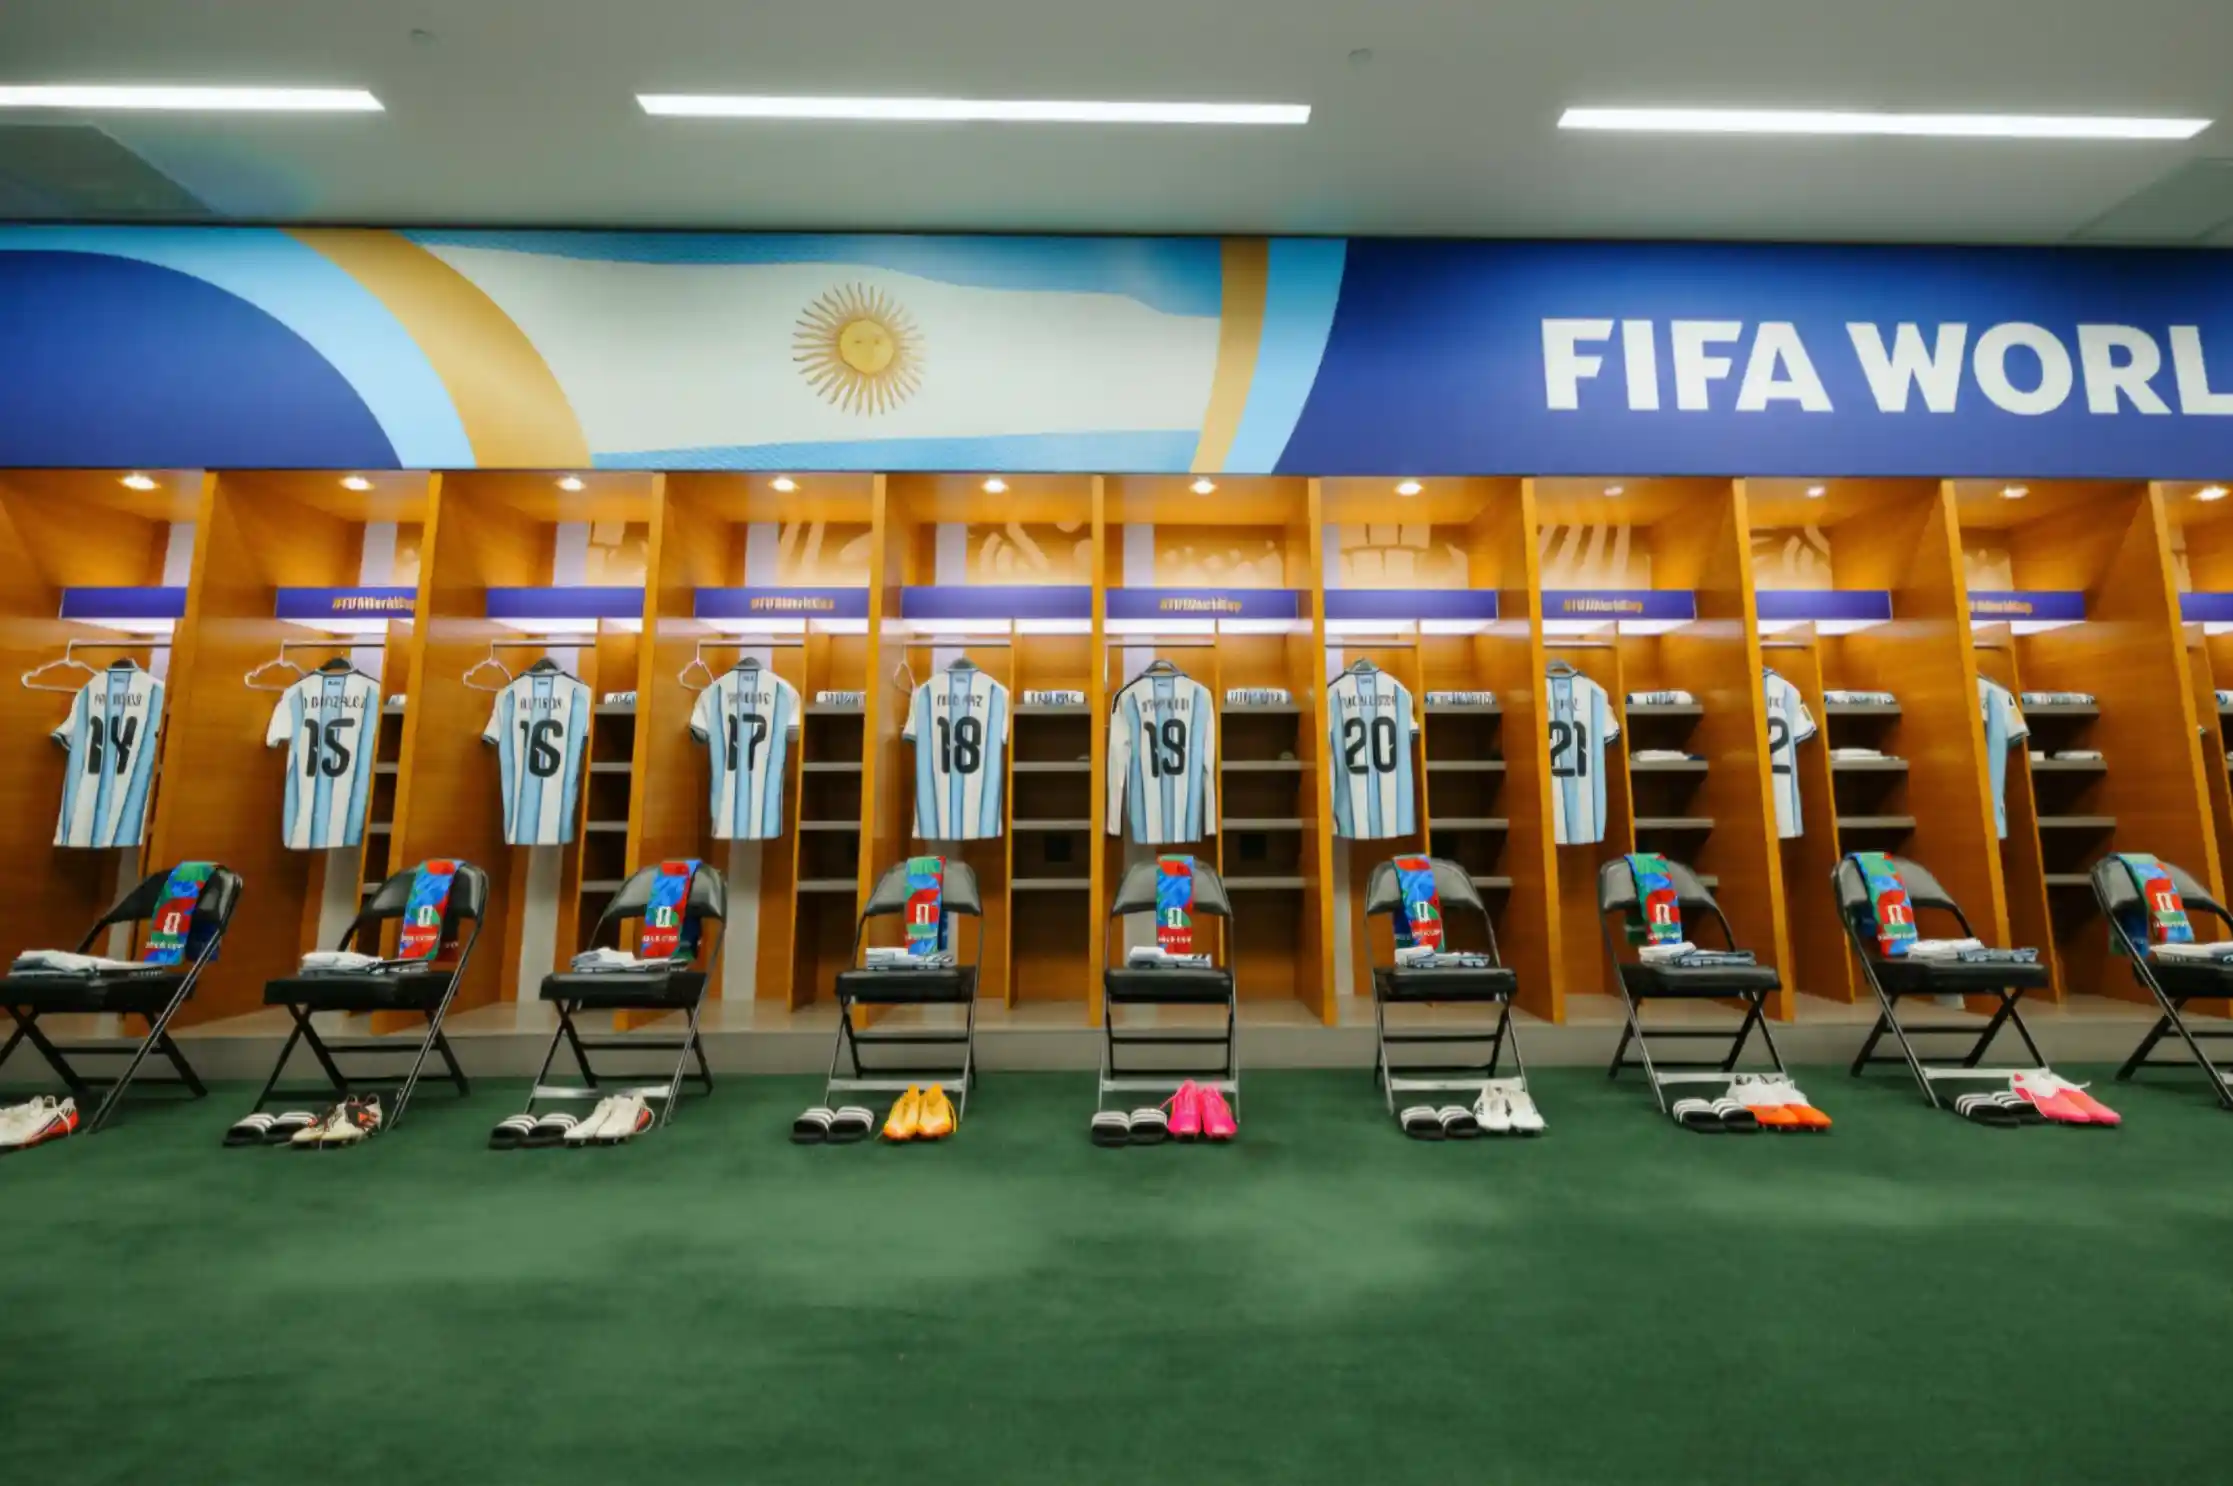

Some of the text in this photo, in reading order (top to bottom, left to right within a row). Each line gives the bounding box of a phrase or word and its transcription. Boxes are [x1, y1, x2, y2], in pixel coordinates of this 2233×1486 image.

[1541, 318, 2233, 416] FIFA WORL
[88, 716, 138, 775] 14
[304, 718, 355, 778] 15
[520, 720, 563, 777] 16
[727, 713, 767, 771] 17
[937, 716, 981, 774] 18
[1144, 718, 1186, 778] 19
[1344, 716, 1397, 773] 20
[1548, 721, 1587, 777] 21
